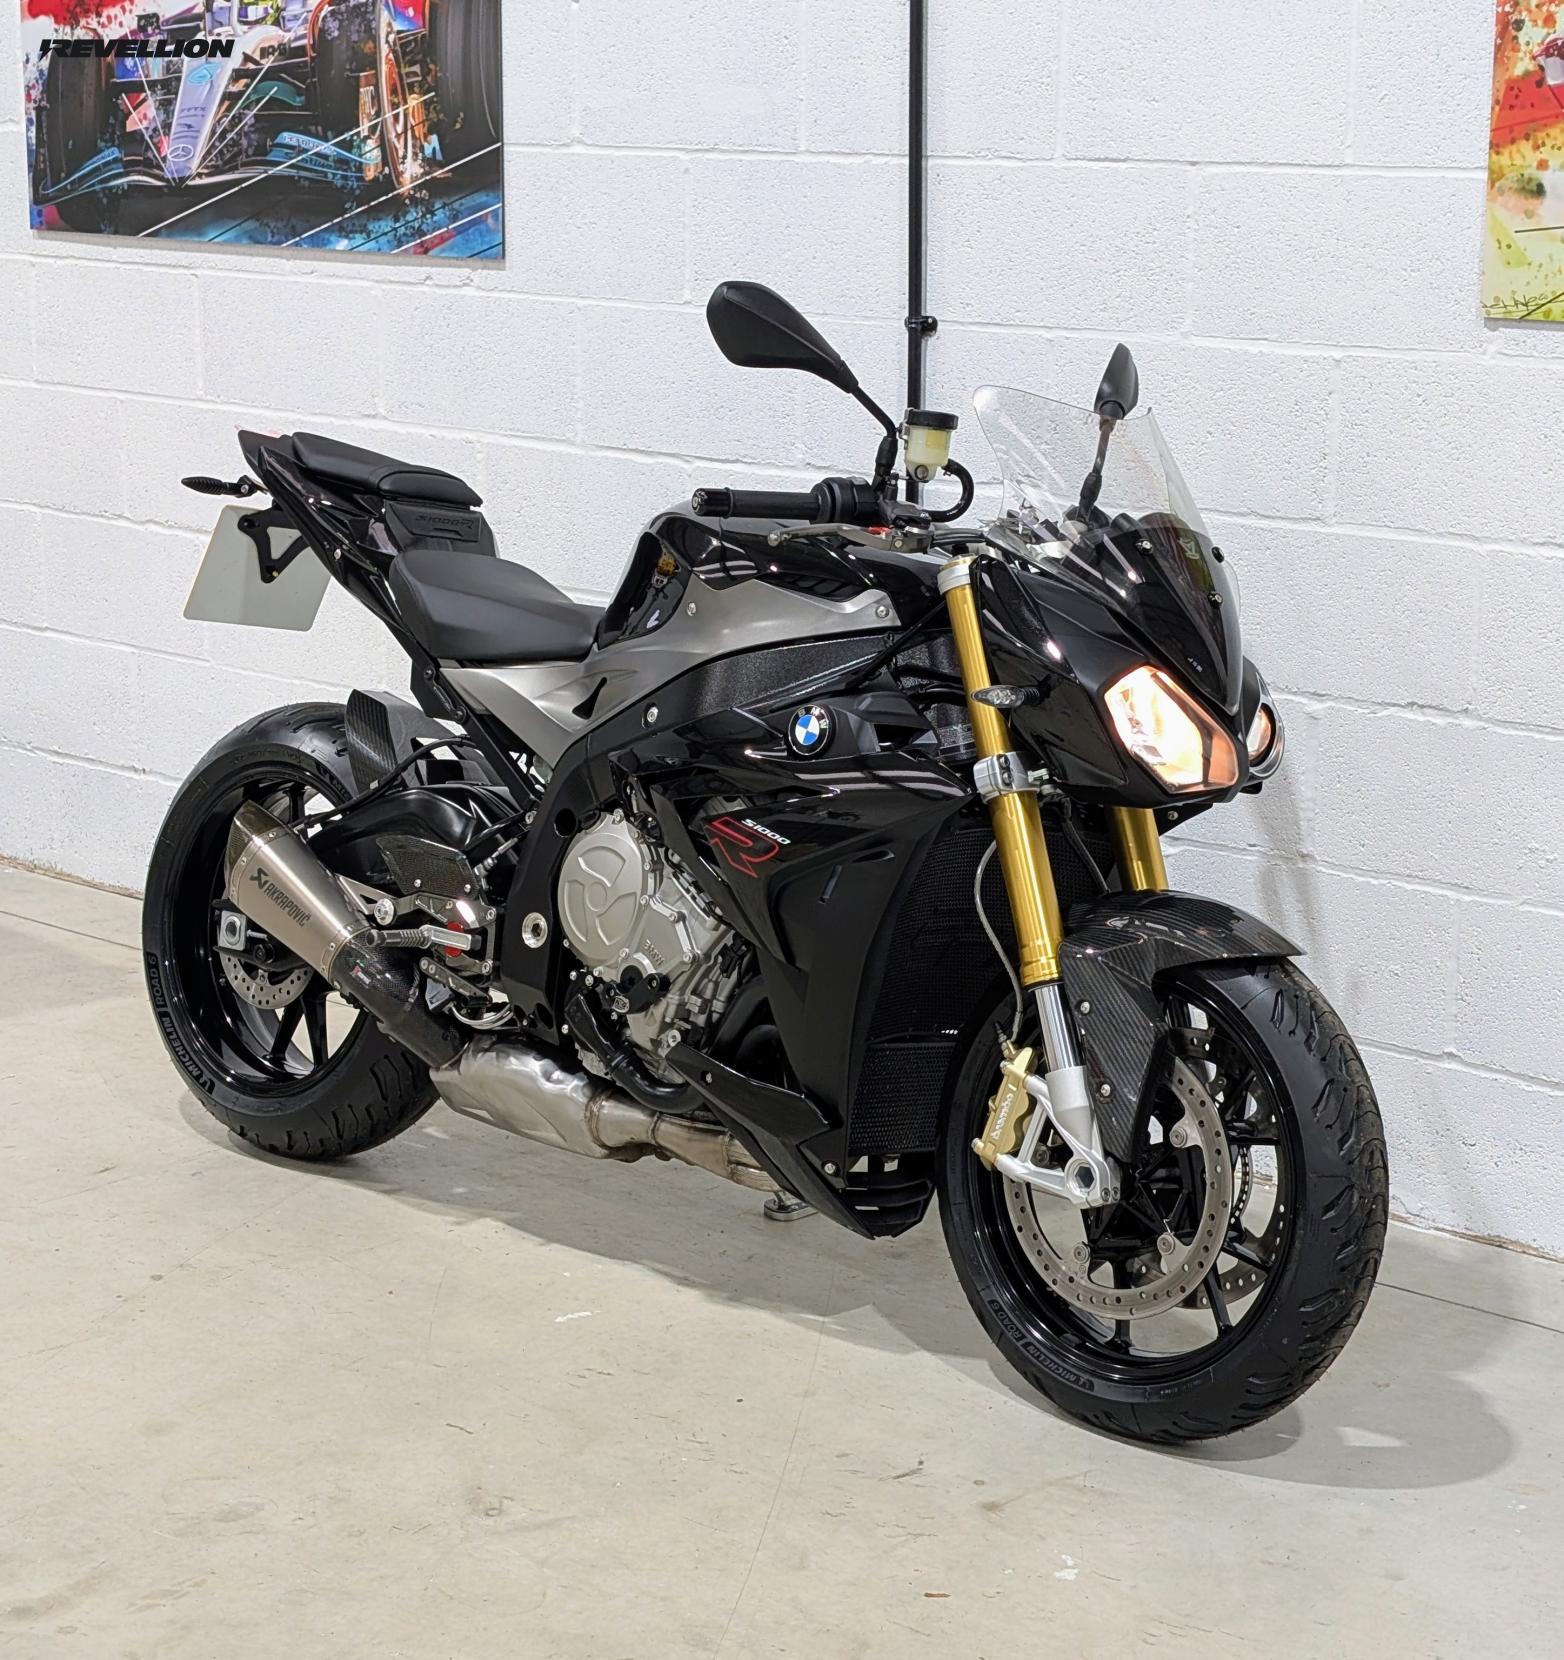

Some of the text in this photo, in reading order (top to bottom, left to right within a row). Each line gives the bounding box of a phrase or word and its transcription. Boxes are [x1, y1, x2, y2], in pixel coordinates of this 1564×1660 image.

[741, 818, 791, 845] S1000
[150, 967, 166, 1005] ROAD
[161, 1016, 202, 1078] MICHELIN
[997, 1310, 1022, 1339] ROAD
[1025, 1344, 1078, 1381] MICHELIN
